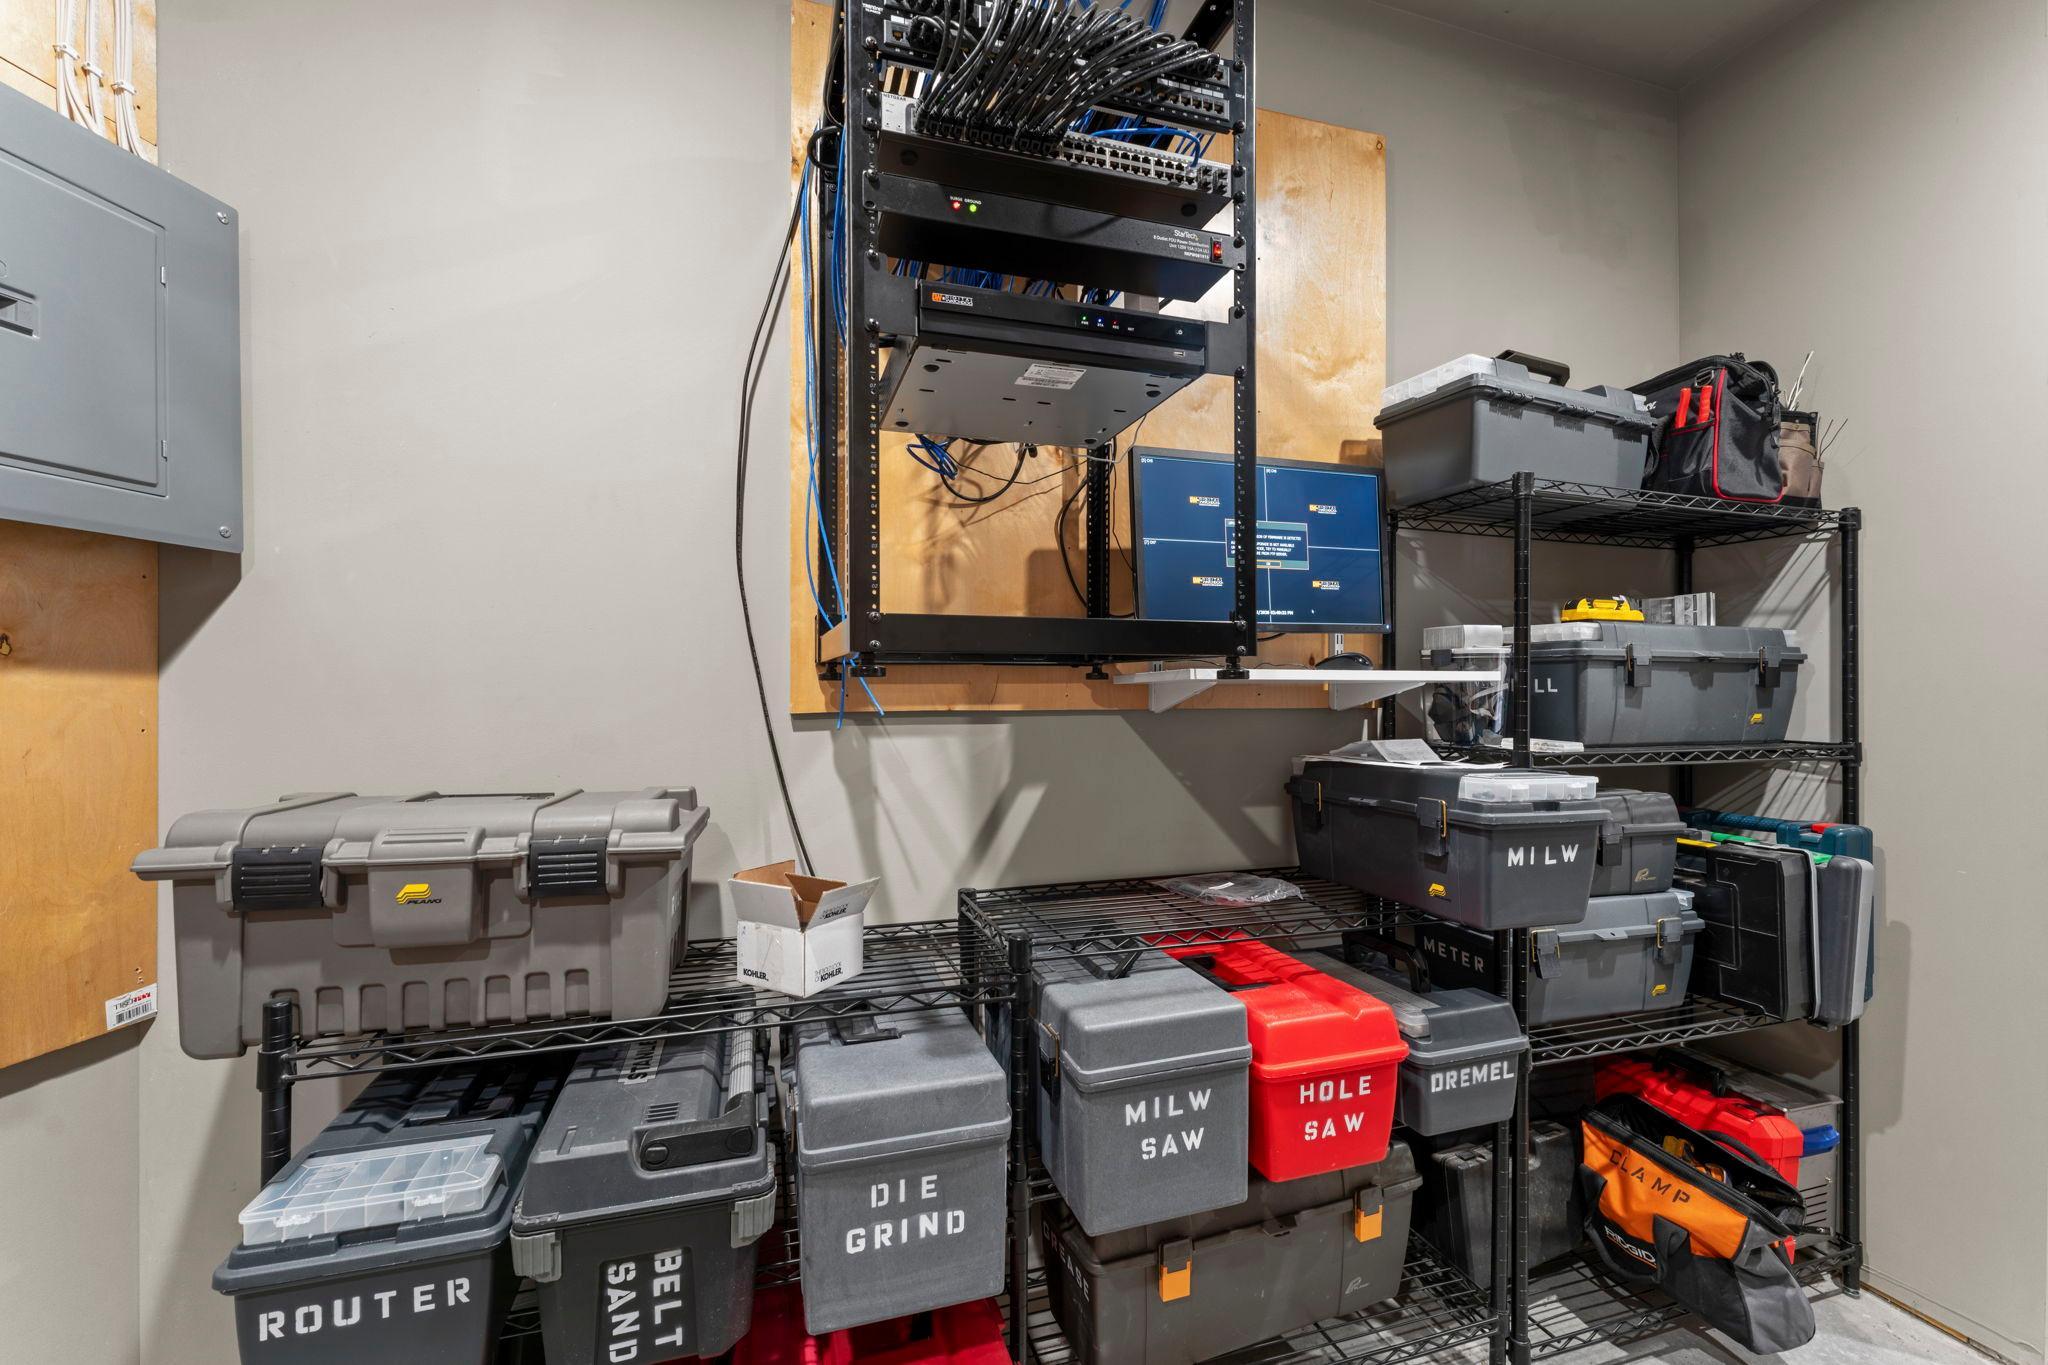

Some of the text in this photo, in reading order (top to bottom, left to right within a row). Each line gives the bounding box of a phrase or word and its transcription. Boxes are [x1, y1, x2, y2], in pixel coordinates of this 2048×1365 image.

[1507, 843, 1579, 867] MILW
[1423, 935, 1484, 973] METER
[628, 1040, 657, 1080] STANLE
[1430, 1060, 1515, 1093] DREMEL
[1125, 1088, 1212, 1126] MILW
[1299, 1075, 1372, 1105] HOLE
[1141, 1127, 1205, 1160] SAW
[1304, 1111, 1365, 1141] SAW
[870, 1174, 938, 1208] DIE
[1609, 1149, 1691, 1203] CLAMP
[845, 1209, 965, 1255] GRIND
[1604, 1225, 1656, 1263] RIDGID
[258, 1277, 471, 1342] ROUTER
[607, 1261, 641, 1363] SAND
[653, 1249, 683, 1347] BELT
